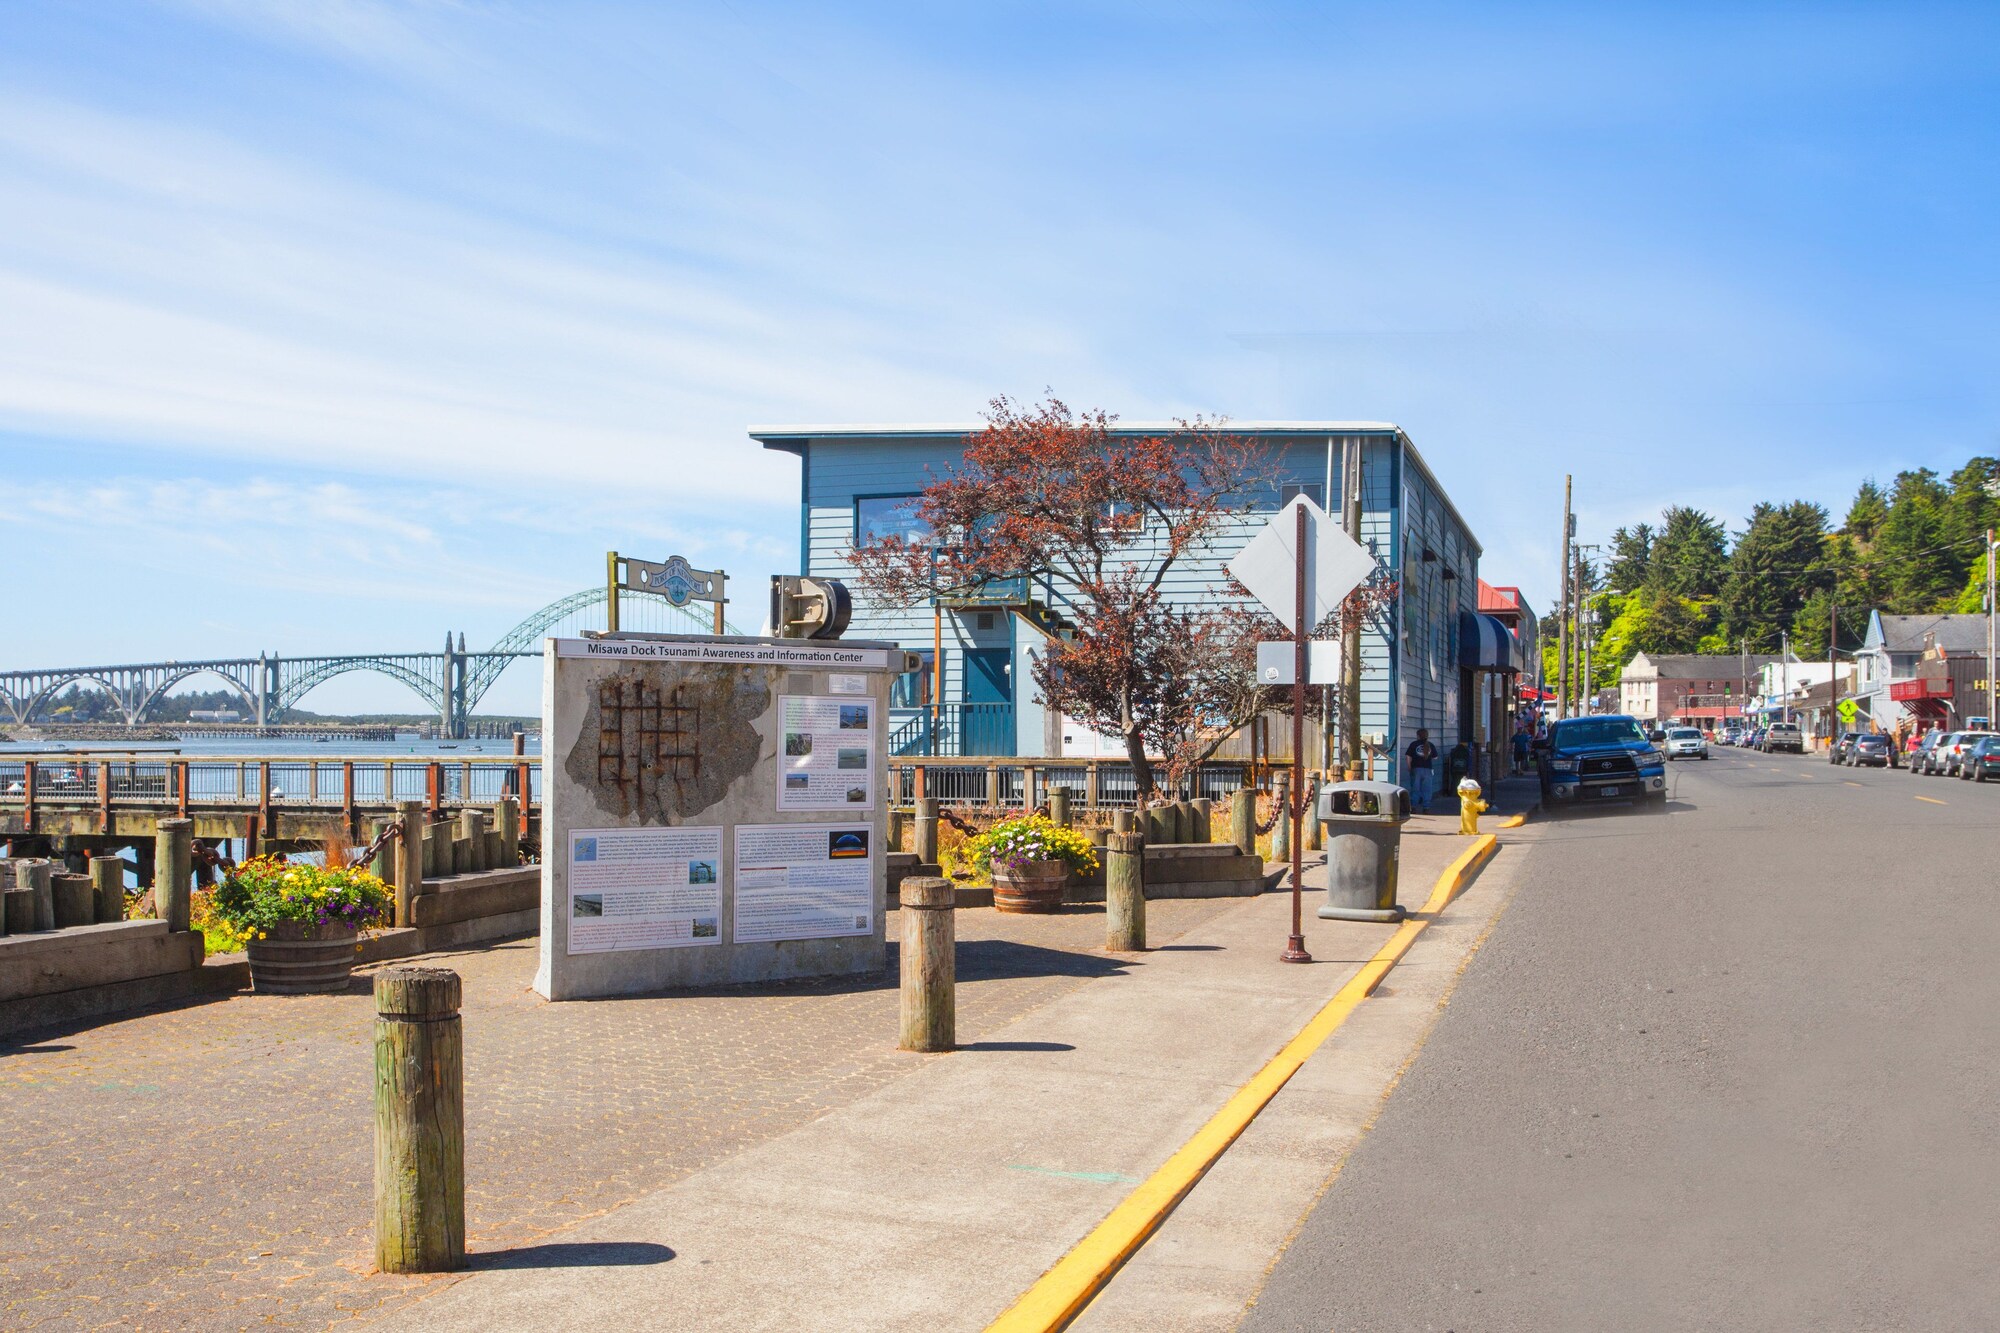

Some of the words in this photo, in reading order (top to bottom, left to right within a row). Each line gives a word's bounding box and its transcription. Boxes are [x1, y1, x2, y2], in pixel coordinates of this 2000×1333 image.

[654, 572, 668, 585] PORT
[677, 567, 701, 590] NEWPORT
[588, 643, 628, 655] Misawa
[631, 645, 656, 656] Dock
[658, 646, 700, 657] Tsunami
[702, 647, 755, 659] Awareness
[757, 650, 775, 660] and
[777, 650, 831, 661] Information
[833, 652, 863, 662] Center
